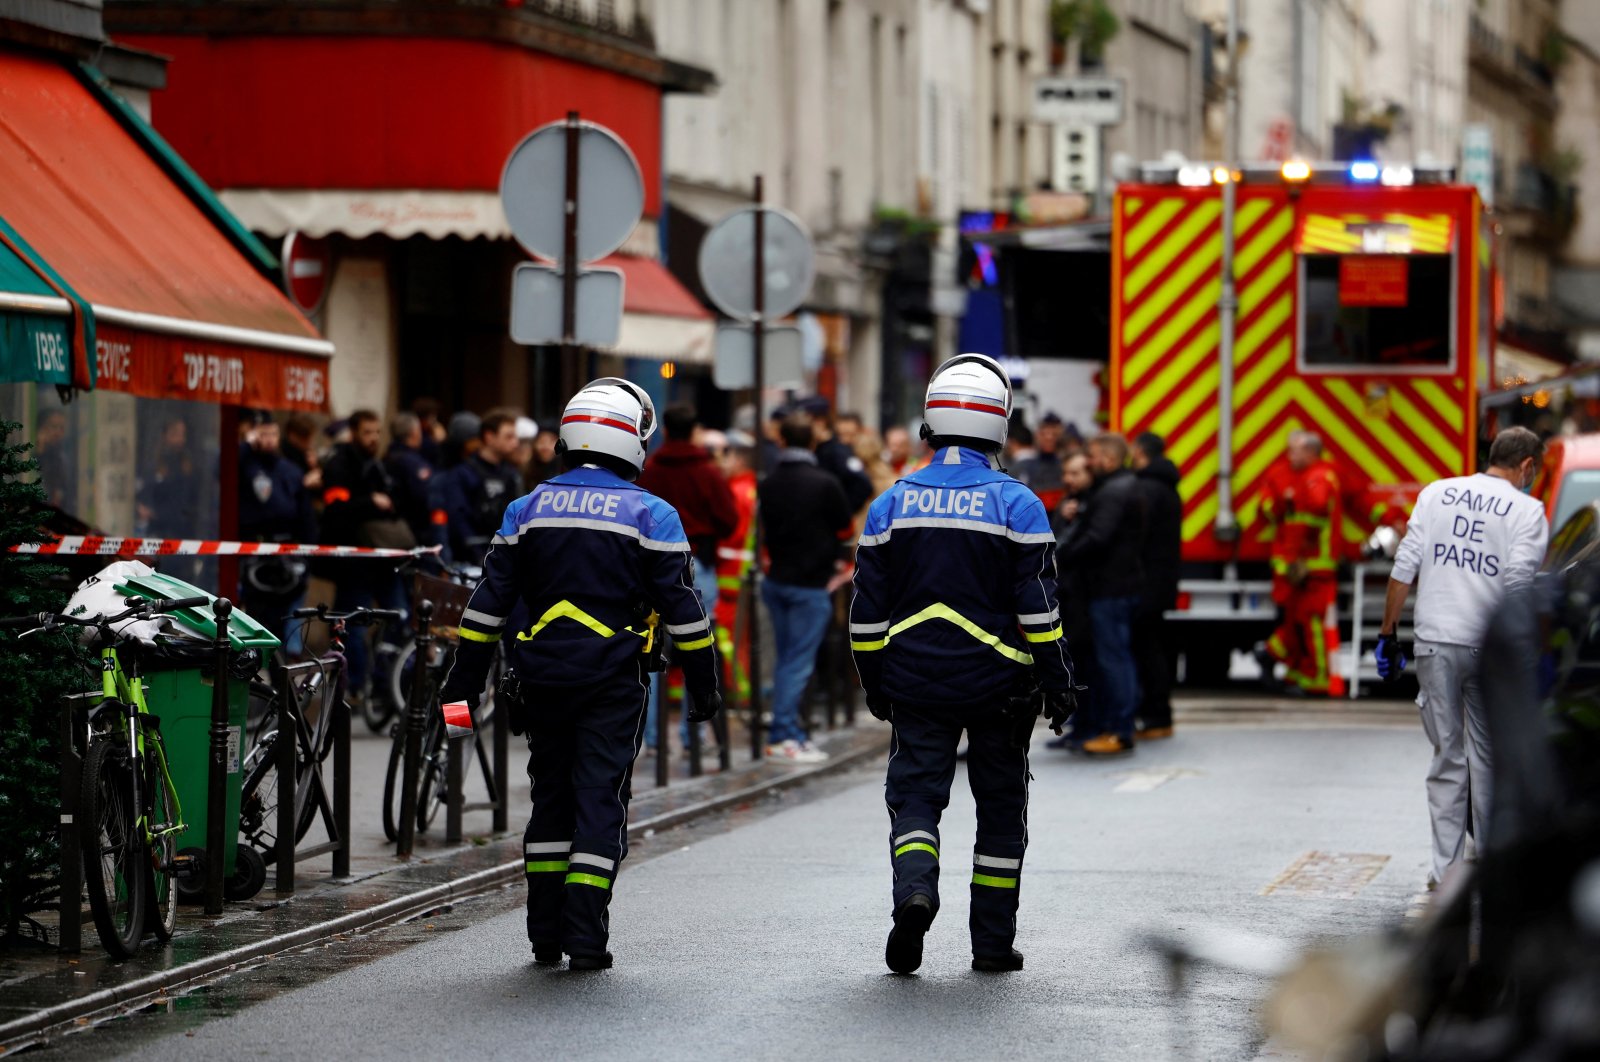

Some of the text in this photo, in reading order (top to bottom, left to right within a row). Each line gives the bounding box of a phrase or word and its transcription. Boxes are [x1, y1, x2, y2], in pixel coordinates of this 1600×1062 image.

[35, 331, 66, 372] IBRE
[96, 340, 131, 382] ERVICE
[536, 490, 621, 517] POLICE
[902, 488, 987, 517] POLICE
[1441, 487, 1513, 517] SAMU
[1452, 515, 1486, 543] DE
[1433, 543, 1499, 577] PARIS
